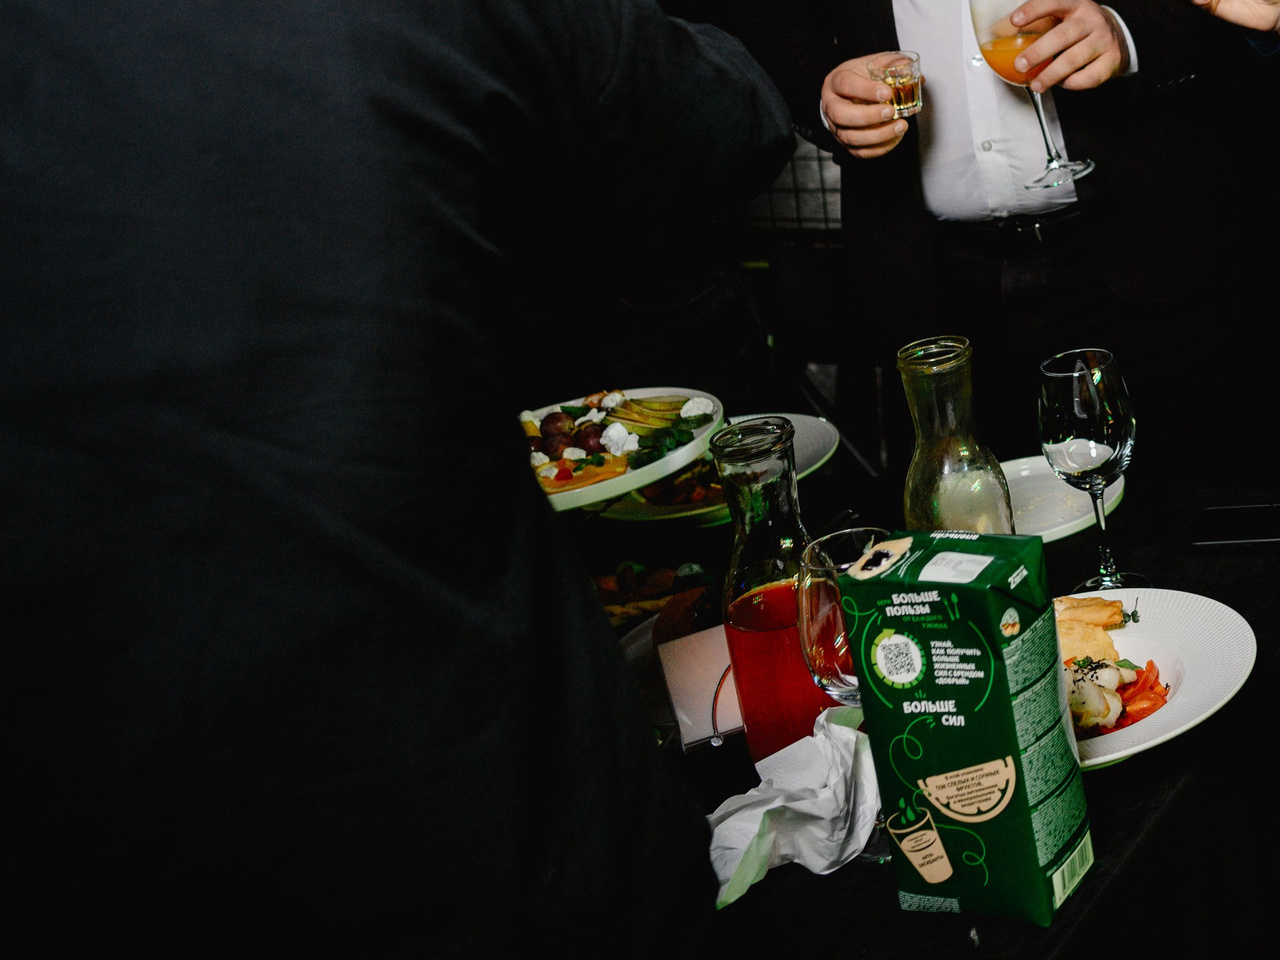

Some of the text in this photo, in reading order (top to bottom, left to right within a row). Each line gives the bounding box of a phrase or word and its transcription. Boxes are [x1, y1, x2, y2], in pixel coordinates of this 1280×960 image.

[891, 590, 941, 605] БОЛЬШЕ
[885, 604, 931, 617] ПОЛЬЗЫ
[921, 622, 948, 630] УЖИНА
[946, 648, 981, 656] ПОЛУЧИТЬ
[932, 655, 960, 663] БОЛЬШЕ
[933, 663, 976, 671] ЖИЗНЕННЫХ
[934, 670, 948, 678] СИЛ
[953, 670, 984, 678] БРЕНДОМ
[902, 700, 957, 714] БОЛЬШЕ
[941, 715, 965, 727] СИЛ
